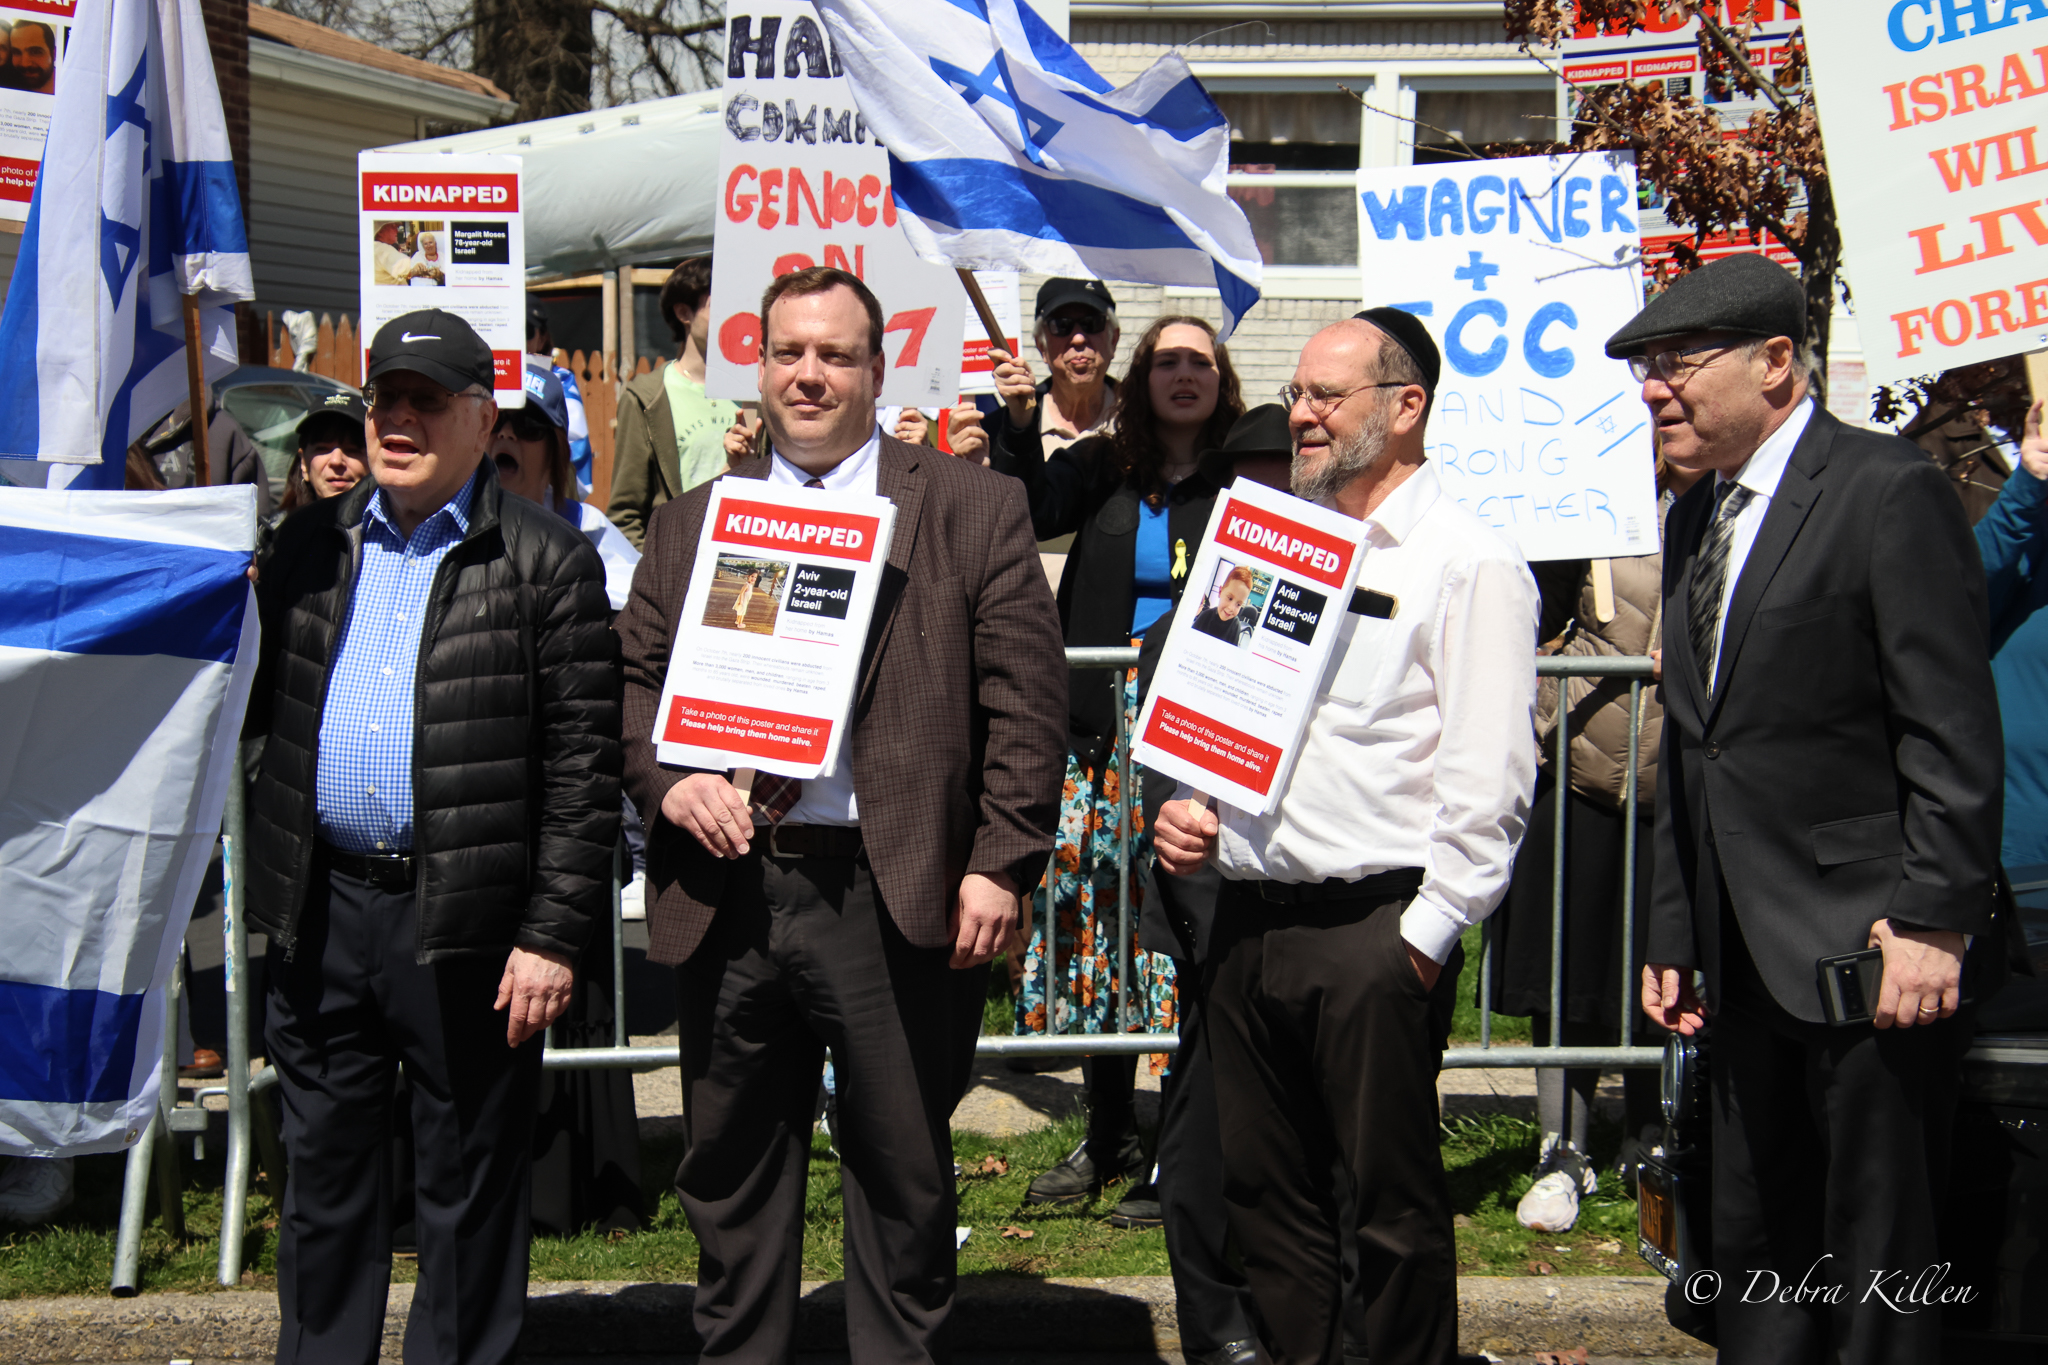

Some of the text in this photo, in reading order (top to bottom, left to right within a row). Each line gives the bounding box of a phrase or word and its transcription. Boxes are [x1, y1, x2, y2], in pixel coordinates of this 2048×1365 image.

[1567, 66, 1624, 79] KIDNAPPED
[1635, 60, 1693, 73] KIDNAPPED
[1883, 46, 2048, 131] ISRA
[725, 92, 884, 147] COMMI
[1929, 126, 2048, 193] WIL
[5, 177, 24, 188] help
[372, 184, 508, 204] KIDNAPPED
[725, 163, 897, 230] GENOCI
[1361, 175, 1638, 243] WAGNER
[454, 230, 506, 239] Margalit Moses
[454, 238, 493, 247] 78-year-old
[1387, 298, 1579, 378] CC
[1440, 386, 1565, 426] AND
[1458, 488, 1617, 536] ETHER
[723, 512, 865, 550] KIDNAPPED
[1225, 514, 1341, 575] KIDNAPPED
[796, 568, 821, 581] Aviv
[789, 596, 823, 610] Israeli
[792, 582, 849, 603] 2-year-old
[1276, 583, 1300, 601] Ariel
[1266, 611, 1296, 633] Israeli
[1270, 597, 1318, 627] 4-year-old
[1282, 652, 1297, 662] Hamas
[679, 706, 699, 717] Take
[704, 710, 727, 722] photo
[727, 713, 736, 722] of
[736, 715, 750, 725] this
[749, 718, 775, 730] poster
[774, 721, 791, 731] and
[790, 724, 813, 735] share
[812, 727, 819, 736] it
[679, 717, 813, 747] Please help bring them home alive.
[1160, 708, 1270, 763] Take a photo of this poster and share it
[1158, 721, 1263, 773] Please help bring them home alive.
